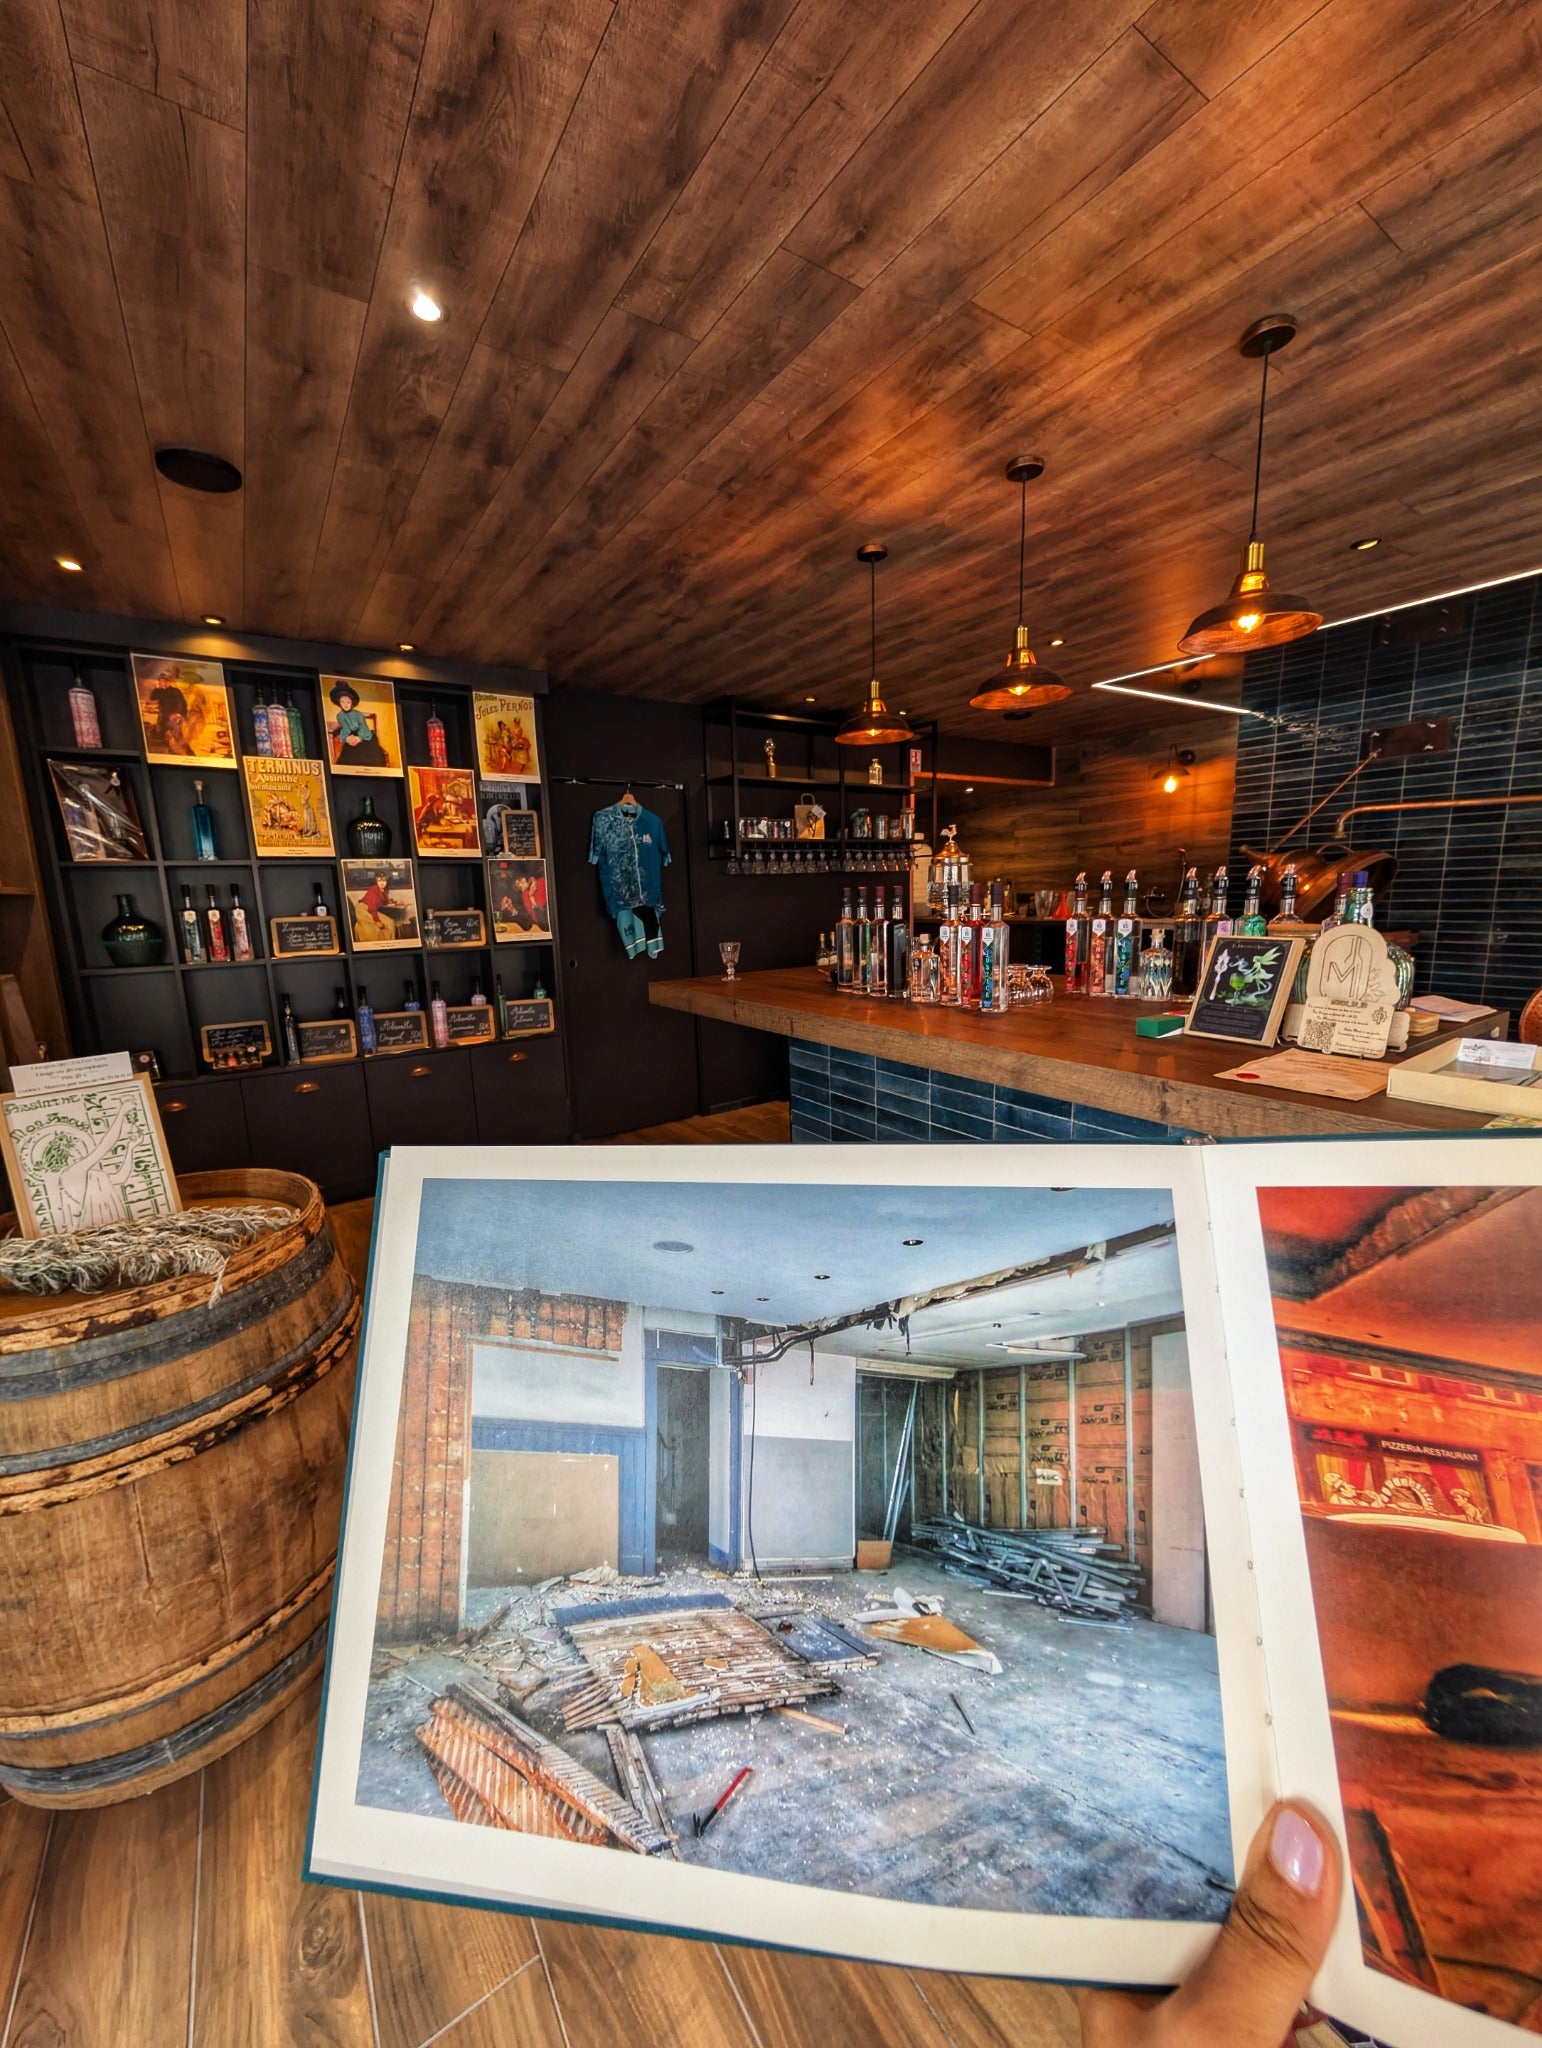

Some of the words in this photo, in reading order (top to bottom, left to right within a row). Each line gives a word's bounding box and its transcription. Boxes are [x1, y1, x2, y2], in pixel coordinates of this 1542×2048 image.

[476, 705, 499, 720] JULES
[247, 758, 321, 777] TERMINUS
[255, 773, 299, 784] Absinthe
